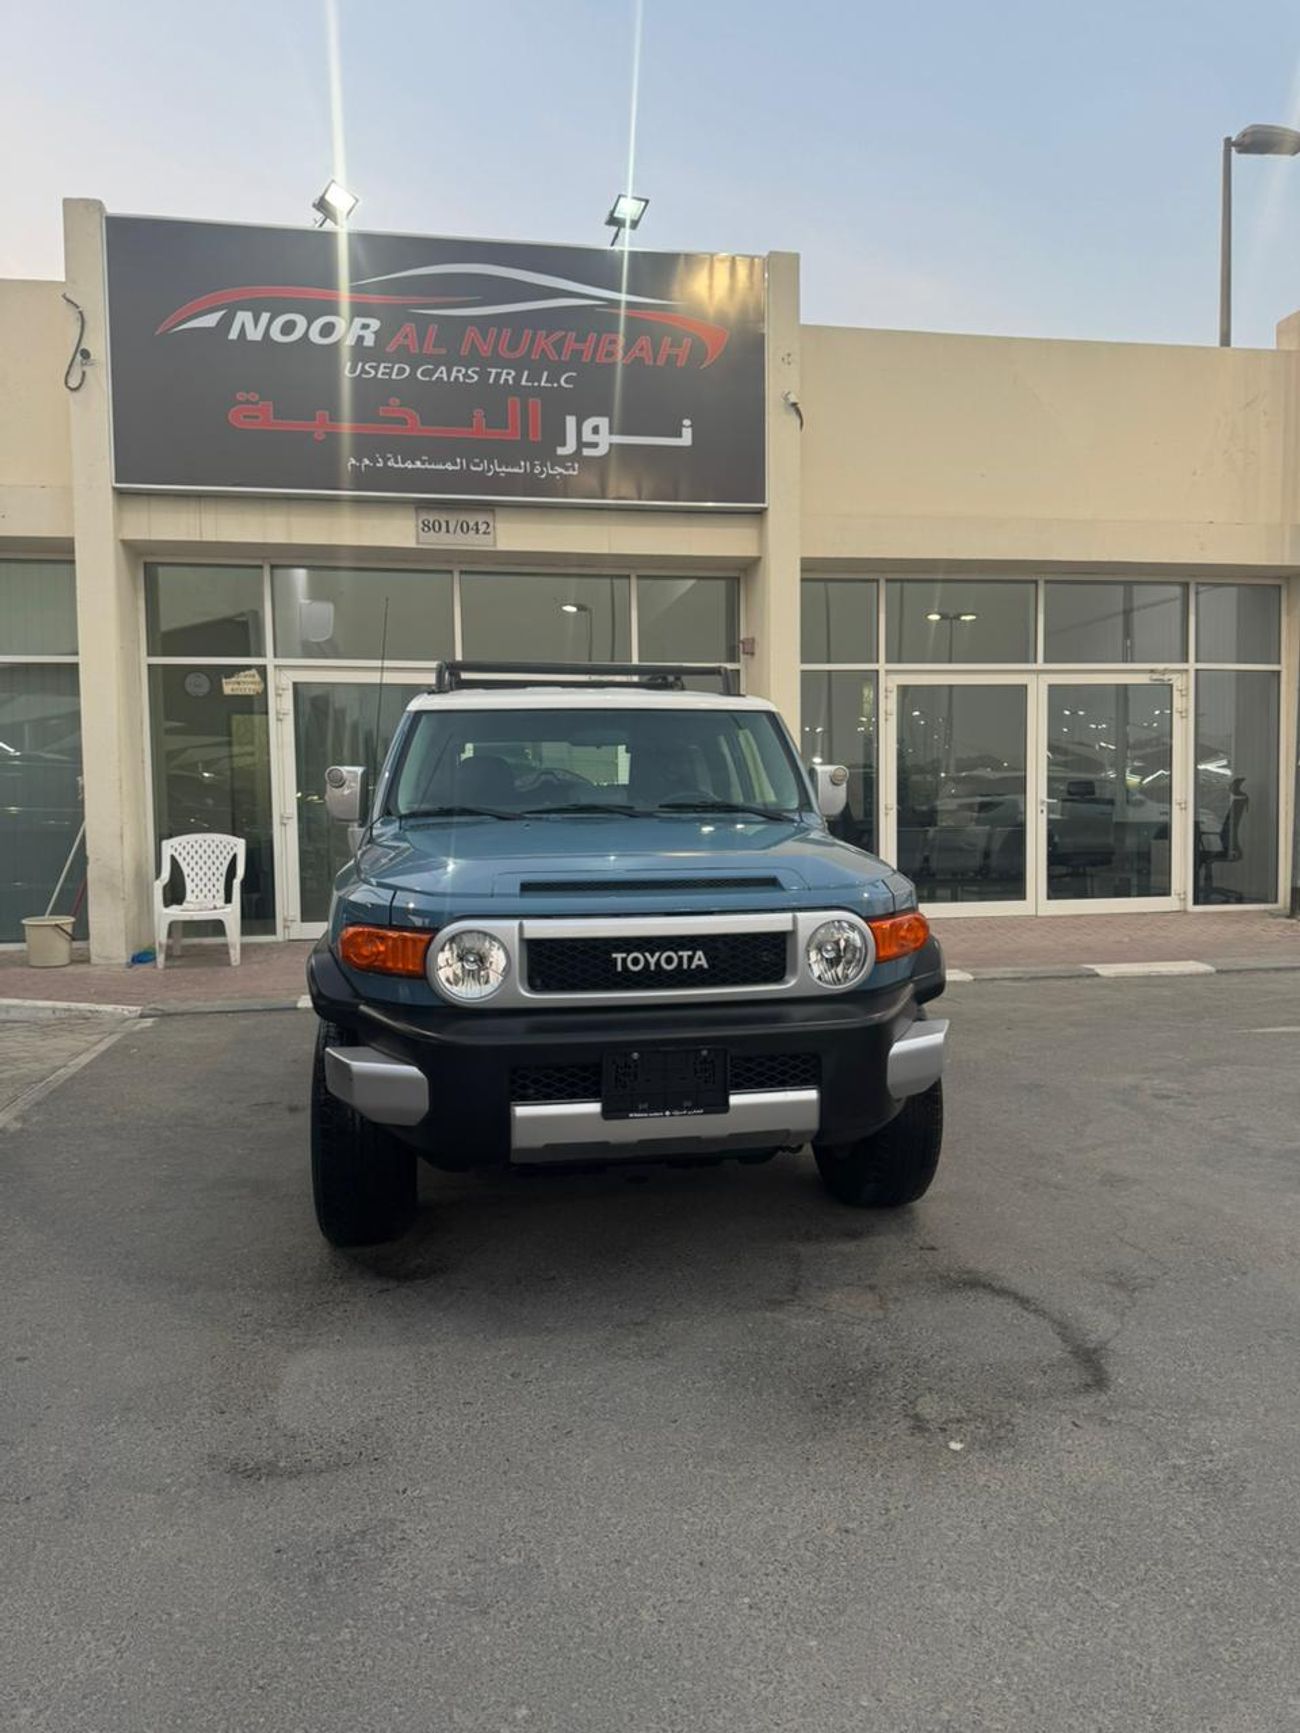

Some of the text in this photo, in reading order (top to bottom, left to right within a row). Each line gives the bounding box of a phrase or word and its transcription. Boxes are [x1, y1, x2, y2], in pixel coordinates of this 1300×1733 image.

[228, 310, 692, 368] NOOR AL NUKHBAH
[344, 361, 577, 388] USED CARS TR L.L.C
[228, 392, 692, 457] نور النخبة
[387, 455, 466, 472] المستعملة
[469, 458, 530, 477] السيارات
[533, 462, 579, 479] لتجارة
[421, 518, 491, 536] 801/042
[611, 950, 709, 972] TOYOTA
